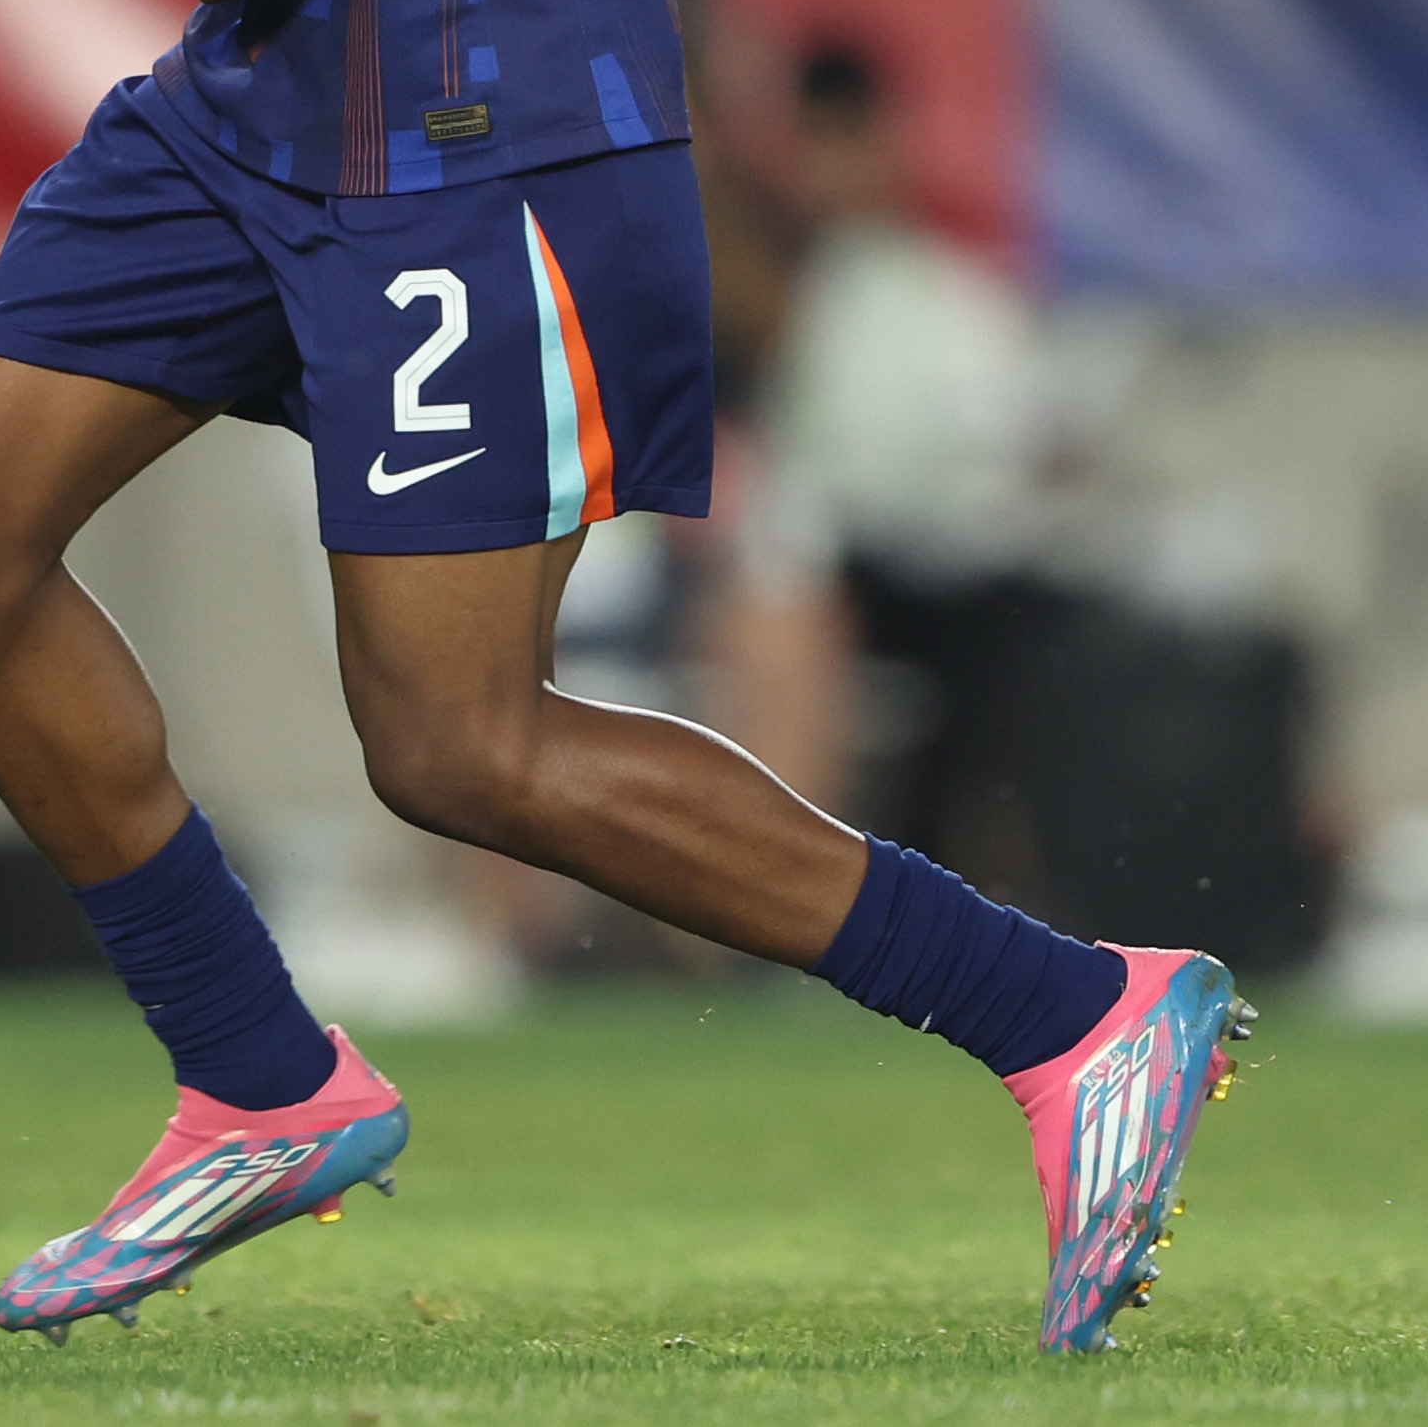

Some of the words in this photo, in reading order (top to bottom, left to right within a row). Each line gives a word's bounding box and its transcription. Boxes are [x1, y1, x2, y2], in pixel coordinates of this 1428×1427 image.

[384, 268, 472, 433] 2
[1080, 1024, 1156, 1133] F50
[192, 1142, 320, 1177] F50
